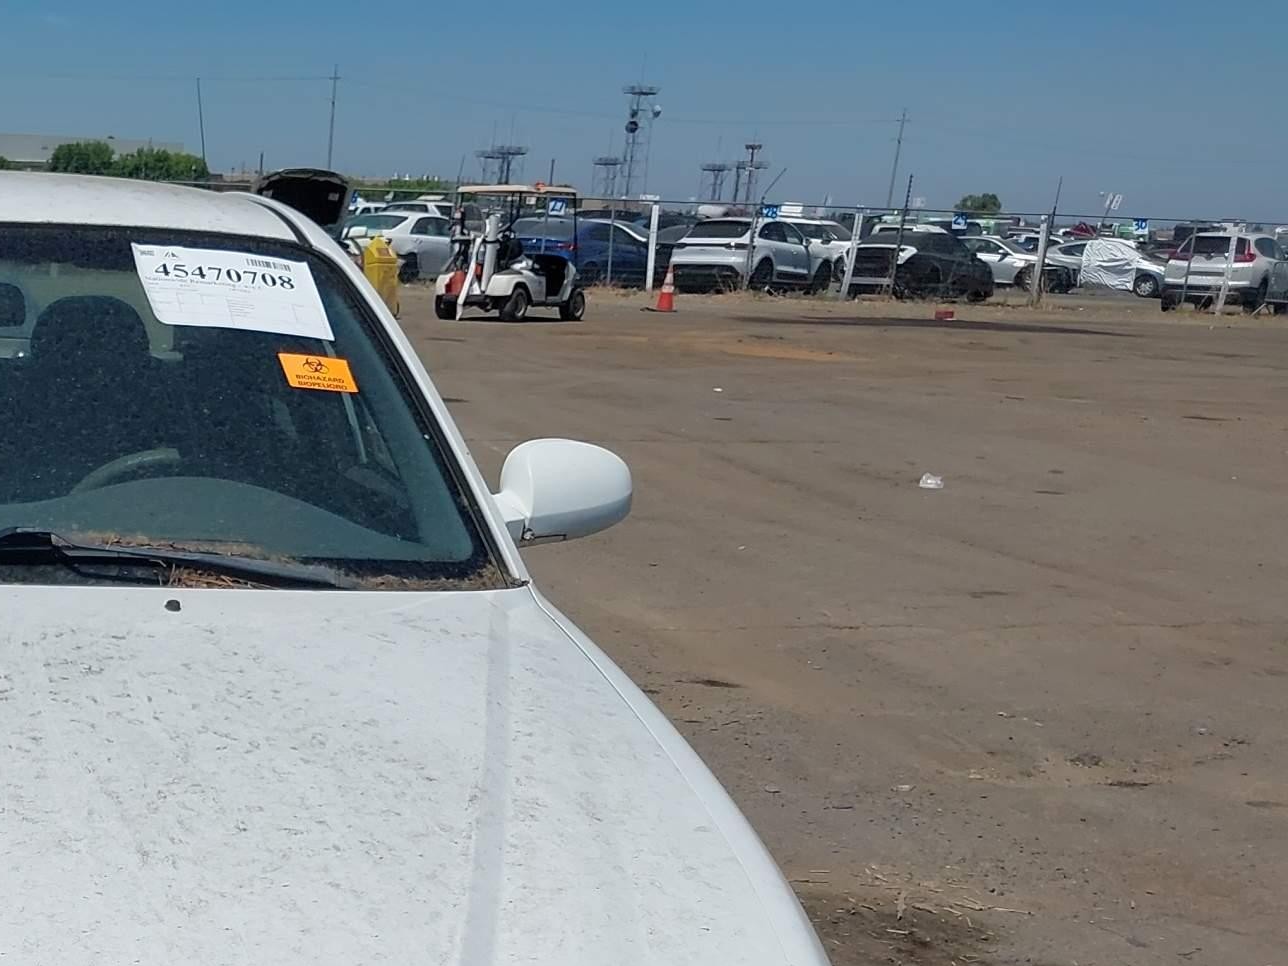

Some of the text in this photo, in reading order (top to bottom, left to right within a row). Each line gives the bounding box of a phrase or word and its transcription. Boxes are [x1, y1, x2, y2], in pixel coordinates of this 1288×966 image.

[762, 206, 778, 219] 28
[953, 213, 968, 226] 29
[1134, 219, 1148, 231] 30
[154, 262, 295, 290] 45470708
[295, 374, 345, 384] BIOHAZARD
